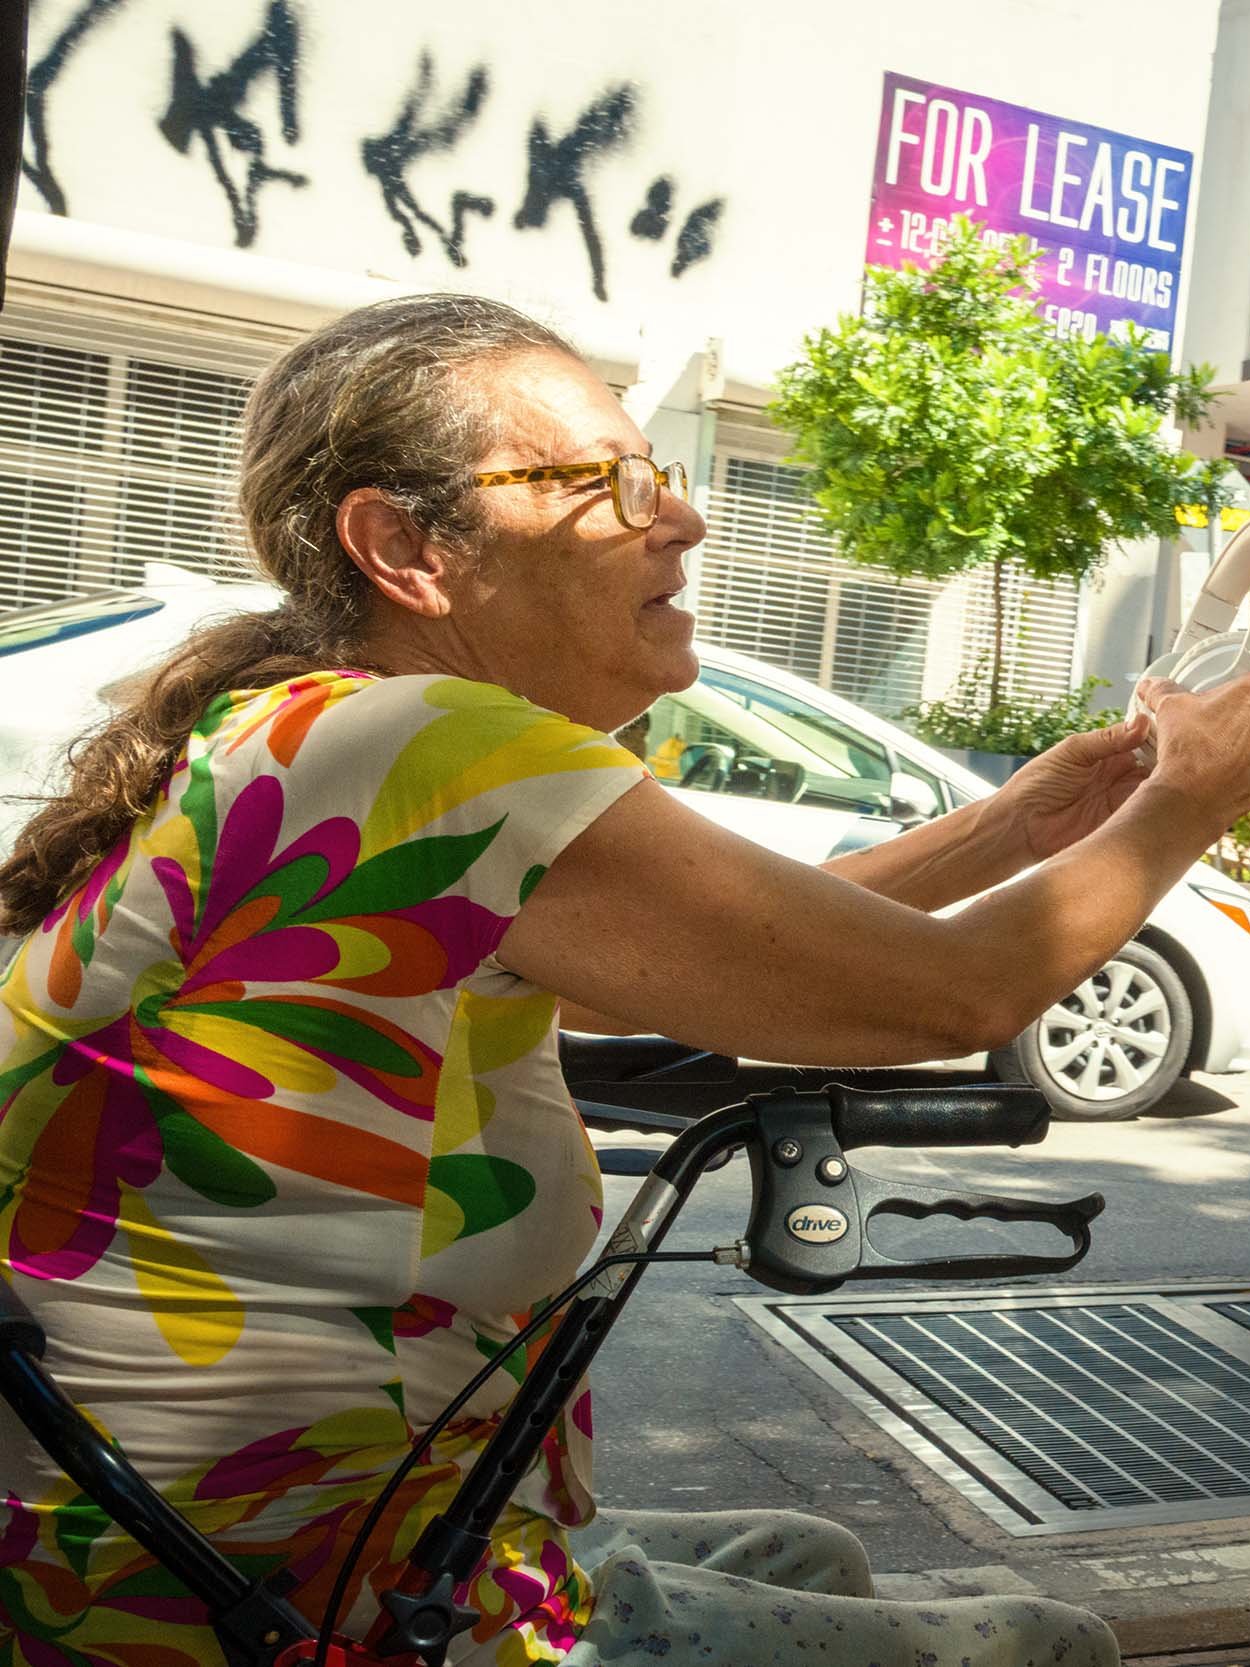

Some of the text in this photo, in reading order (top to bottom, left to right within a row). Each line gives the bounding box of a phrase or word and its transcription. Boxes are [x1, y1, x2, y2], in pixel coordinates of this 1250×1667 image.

[886, 88, 1186, 253] FOR LEASE
[1056, 247, 1075, 287] 2
[1084, 254, 1173, 309] FLOORS
[792, 1216, 841, 1231] drive
